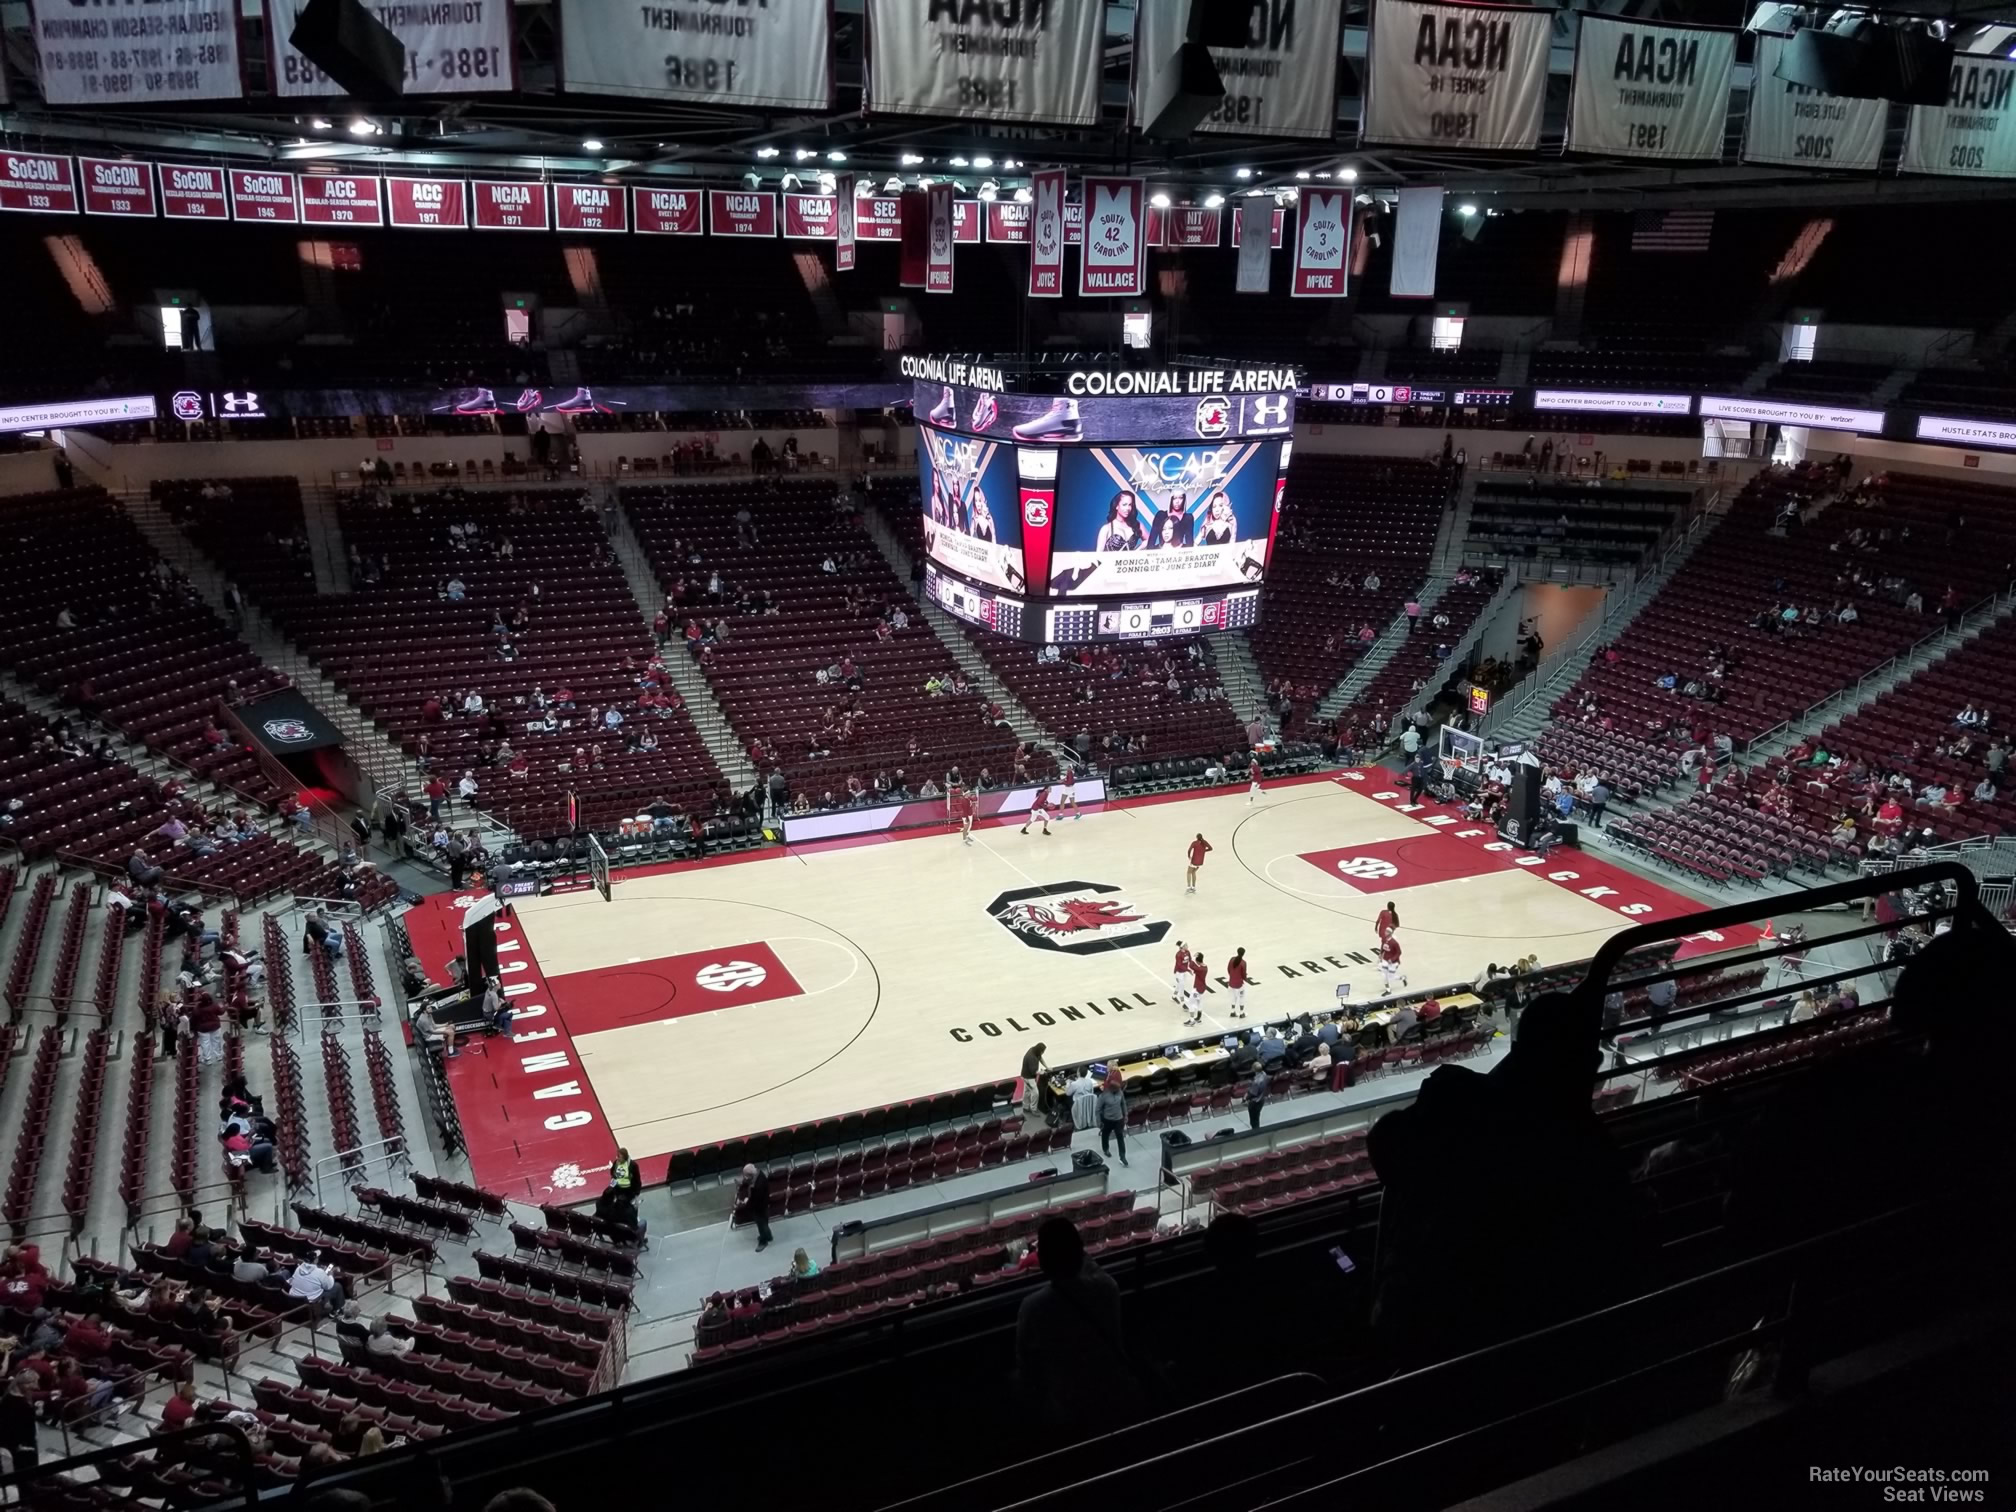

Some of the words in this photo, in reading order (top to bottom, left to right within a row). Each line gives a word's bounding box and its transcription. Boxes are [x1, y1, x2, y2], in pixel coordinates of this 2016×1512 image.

[325, 180, 356, 198] ACC
[412, 184, 443, 201] ACC
[491, 186, 530, 204] NCAA
[27, 195, 50, 208] 1933
[111, 199, 131, 211] 1933
[572, 189, 610, 207] NCAA
[651, 193, 687, 210] NCAA
[726, 195, 760, 212] NCAA
[186, 203, 206, 214] 1934
[257, 207, 276, 218] 1945
[799, 199, 832, 216] NCAA
[874, 201, 896, 217] SEC
[1000, 205, 1030, 220] NCAA
[331, 210, 353, 221] 1970
[418, 213, 439, 223] 1971
[502, 215, 522, 226] 1971
[582, 217, 602, 227] 1972
[1100, 216, 1126, 225] SOUTH
[1187, 211, 1203, 225] NIT
[660, 221, 678, 231] 1973
[734, 222, 753, 233] 1974
[876, 228, 893, 237] 1997
[1043, 223, 1052, 239] 43
[1313, 219, 1336, 231] SOUTH
[1104, 226, 1120, 242] 42
[1319, 232, 1327, 246] 3
[1093, 242, 1130, 257] CAROLINA
[1306, 245, 1339, 261] CAROLINA
[1037, 272, 1056, 287] JOYCE
[1087, 272, 1135, 287] WALLACE
[901, 356, 946, 383] COLONIAL
[948, 362, 967, 387] LIFE
[968, 365, 1005, 393] ARENA
[1067, 371, 1181, 396] COLONIAL
[1188, 370, 1224, 393] LIFE
[1229, 369, 1297, 393] ARENA
[1335, 387, 1345, 399] 0
[1375, 388, 1386, 399] 0
[1556, 398, 1582, 406] CENTER
[1583, 398, 1614, 407] BROUGHT
[2, 416, 20, 424] INFO
[21, 414, 49, 423] CENTER
[50, 411, 82, 420] BROUGHT
[94, 408, 108, 416] YOU
[1732, 406, 1757, 415] SCORES
[1757, 408, 1788, 418] BROUGHT
[1799, 412, 1813, 420] YOU
[1814, 414, 1826, 422] BY:
[1830, 415, 1854, 424] verizon
[1942, 426, 1970, 436] HUSTLE
[1972, 429, 1997, 438] STATS
[1128, 450, 1230, 482] XSCAPE
[1115, 558, 1150, 567] MONICA
[1156, 556, 1183, 564] TAMAR
[1185, 553, 1220, 562] BRAXTON
[1116, 565, 1160, 574] ZONNIQUE
[1193, 560, 1217, 569] DIARY
[968, 598, 975, 613] 0
[1129, 614, 1141, 629] 0
[1182, 610, 1194, 624] 0
[1473, 696, 1485, 711] 30
[1372, 791, 1654, 916] GAMECOCKS
[1337, 856, 1399, 880] SEC
[513, 885, 535, 893] FAST!
[949, 992, 1157, 1045] COLONIAL
